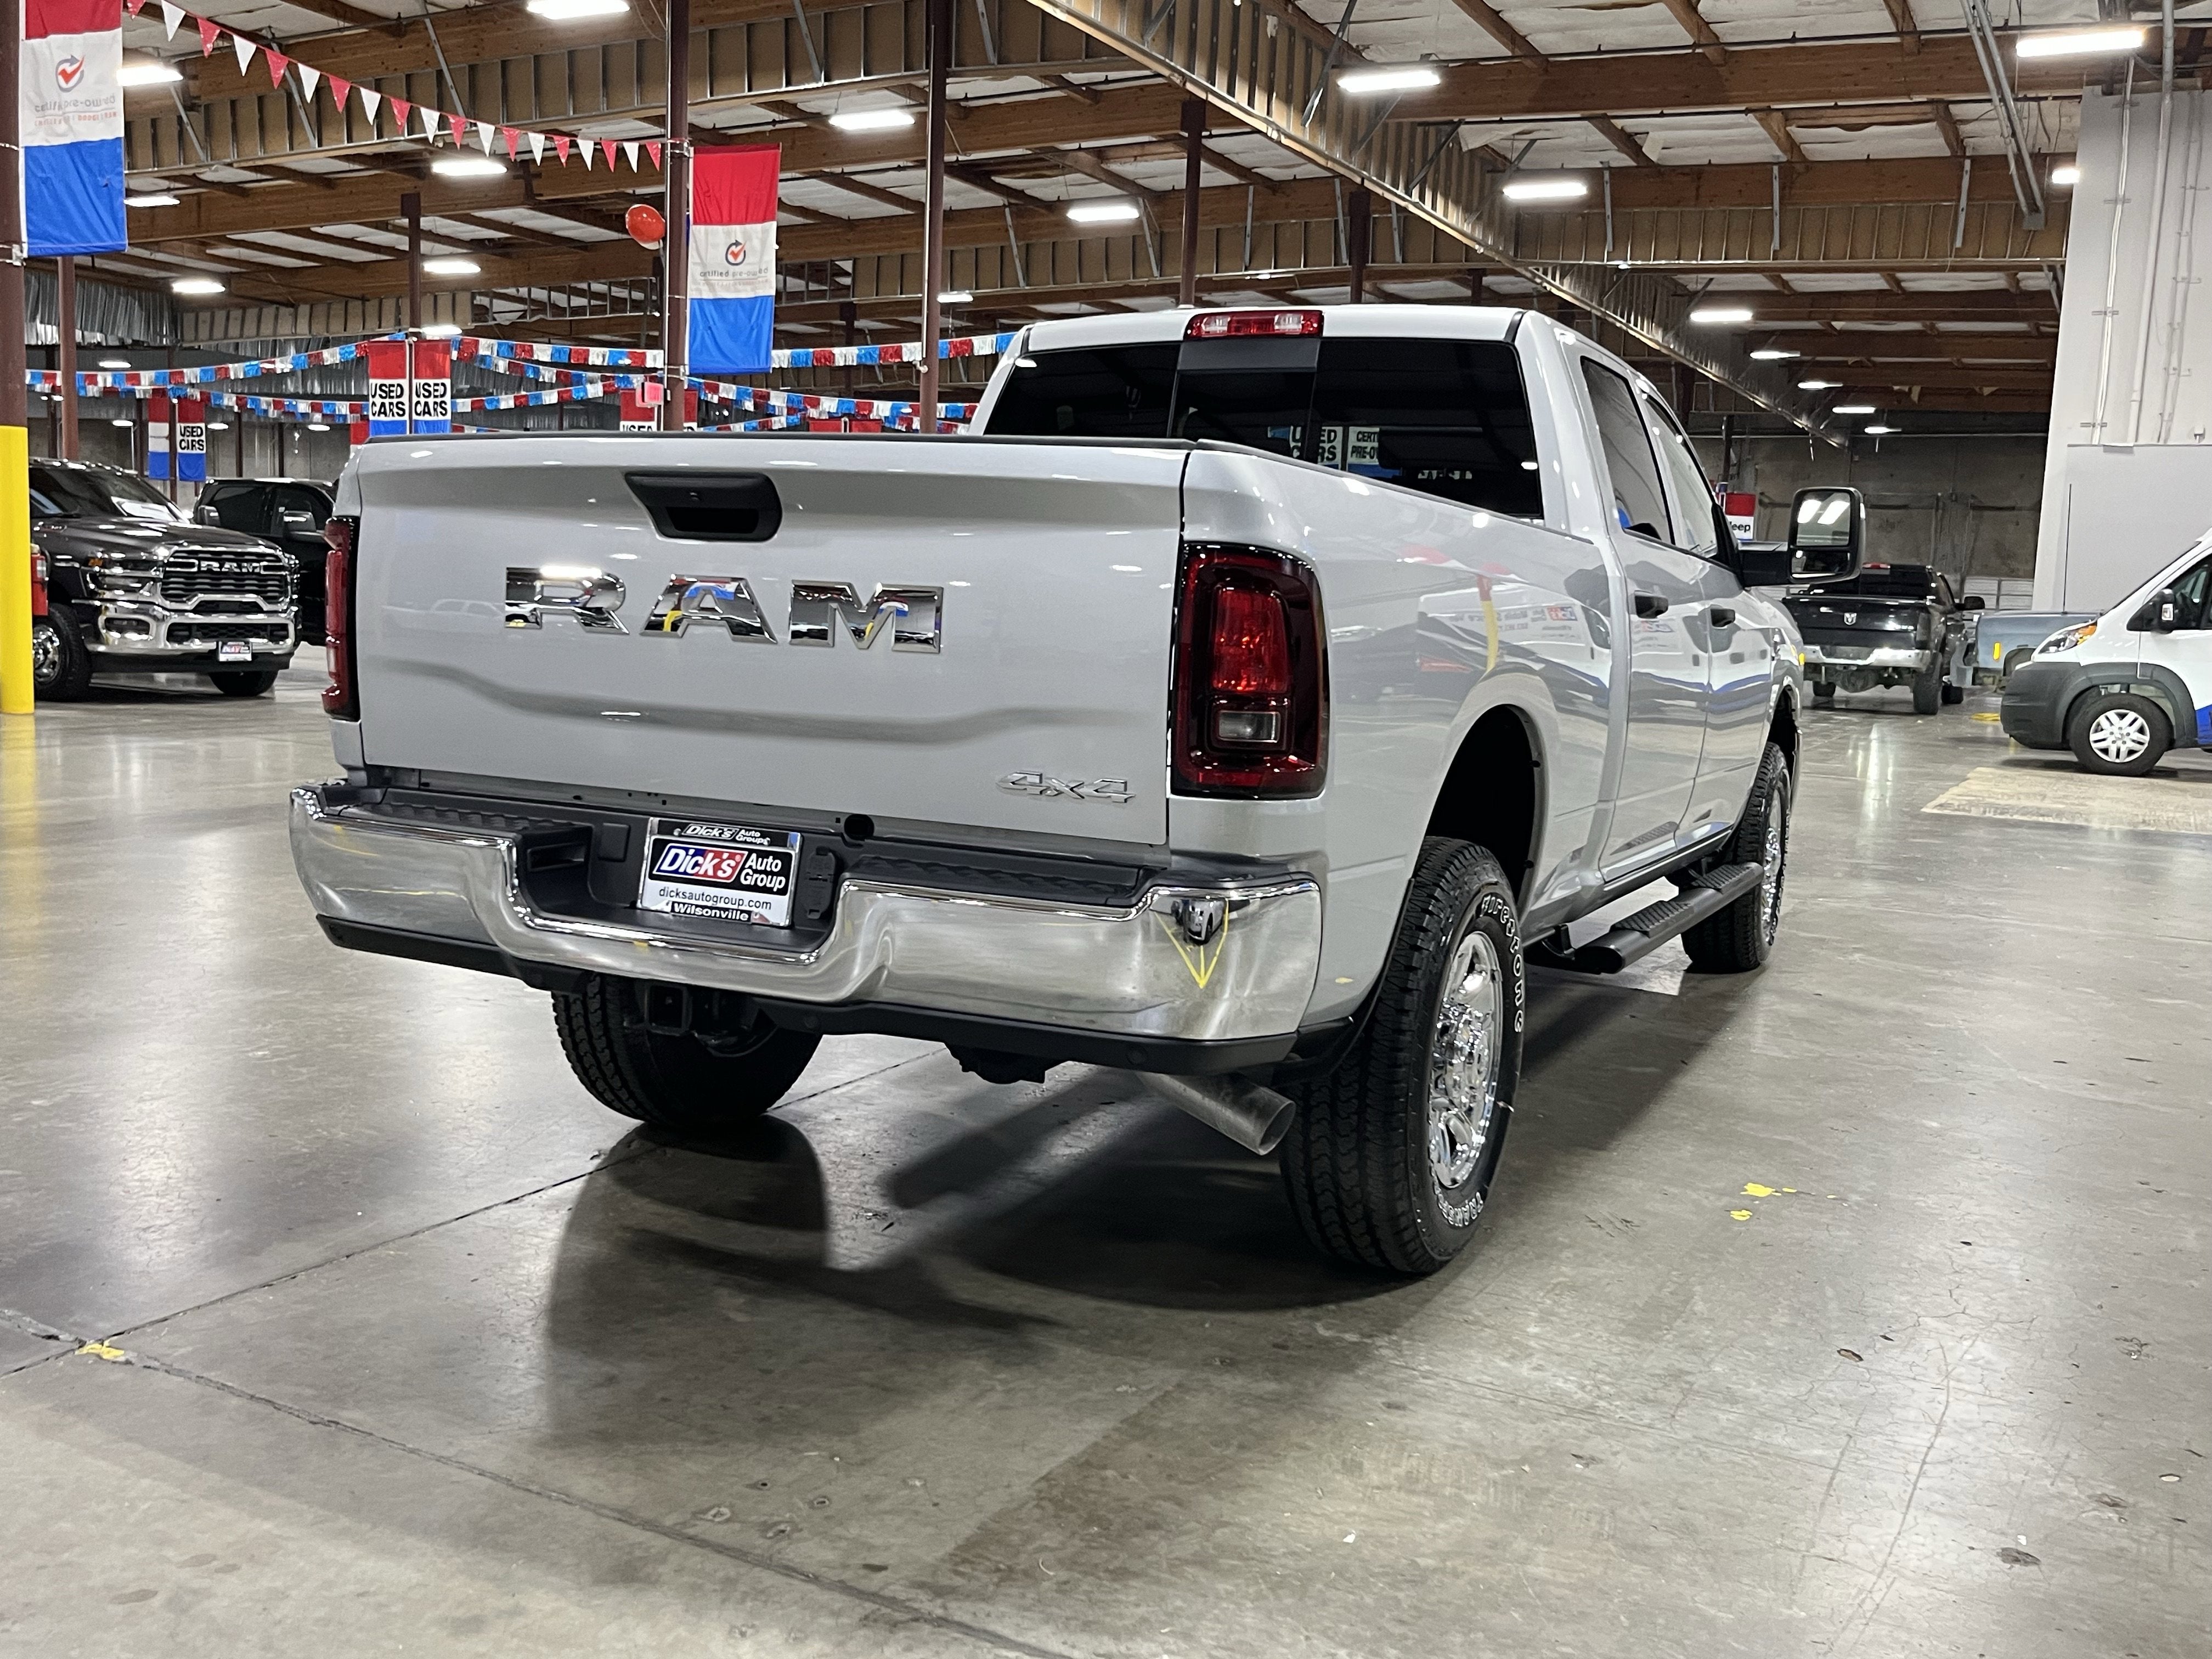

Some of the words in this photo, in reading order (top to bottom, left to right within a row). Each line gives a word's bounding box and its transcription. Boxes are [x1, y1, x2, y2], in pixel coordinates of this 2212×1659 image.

[370, 382, 404, 399] USED
[415, 382, 447, 399] USED
[371, 400, 406, 417] CARS
[414, 400, 448, 417] CARS
[179, 425, 204, 438] USED
[1291, 428, 1337, 444] UED
[1291, 445, 1336, 462] CRS
[1729, 521, 1751, 533] eep
[200, 561, 260, 572] RAM
[505, 566, 944, 654] RAM
[738, 829, 761, 838] Auto
[660, 848, 737, 878] Dick's
[745, 853, 782, 873] Auto
[740, 871, 786, 891] Group
[659, 886, 772, 911] dicksautogroup.com
[674, 902, 749, 922] Wilsonville
